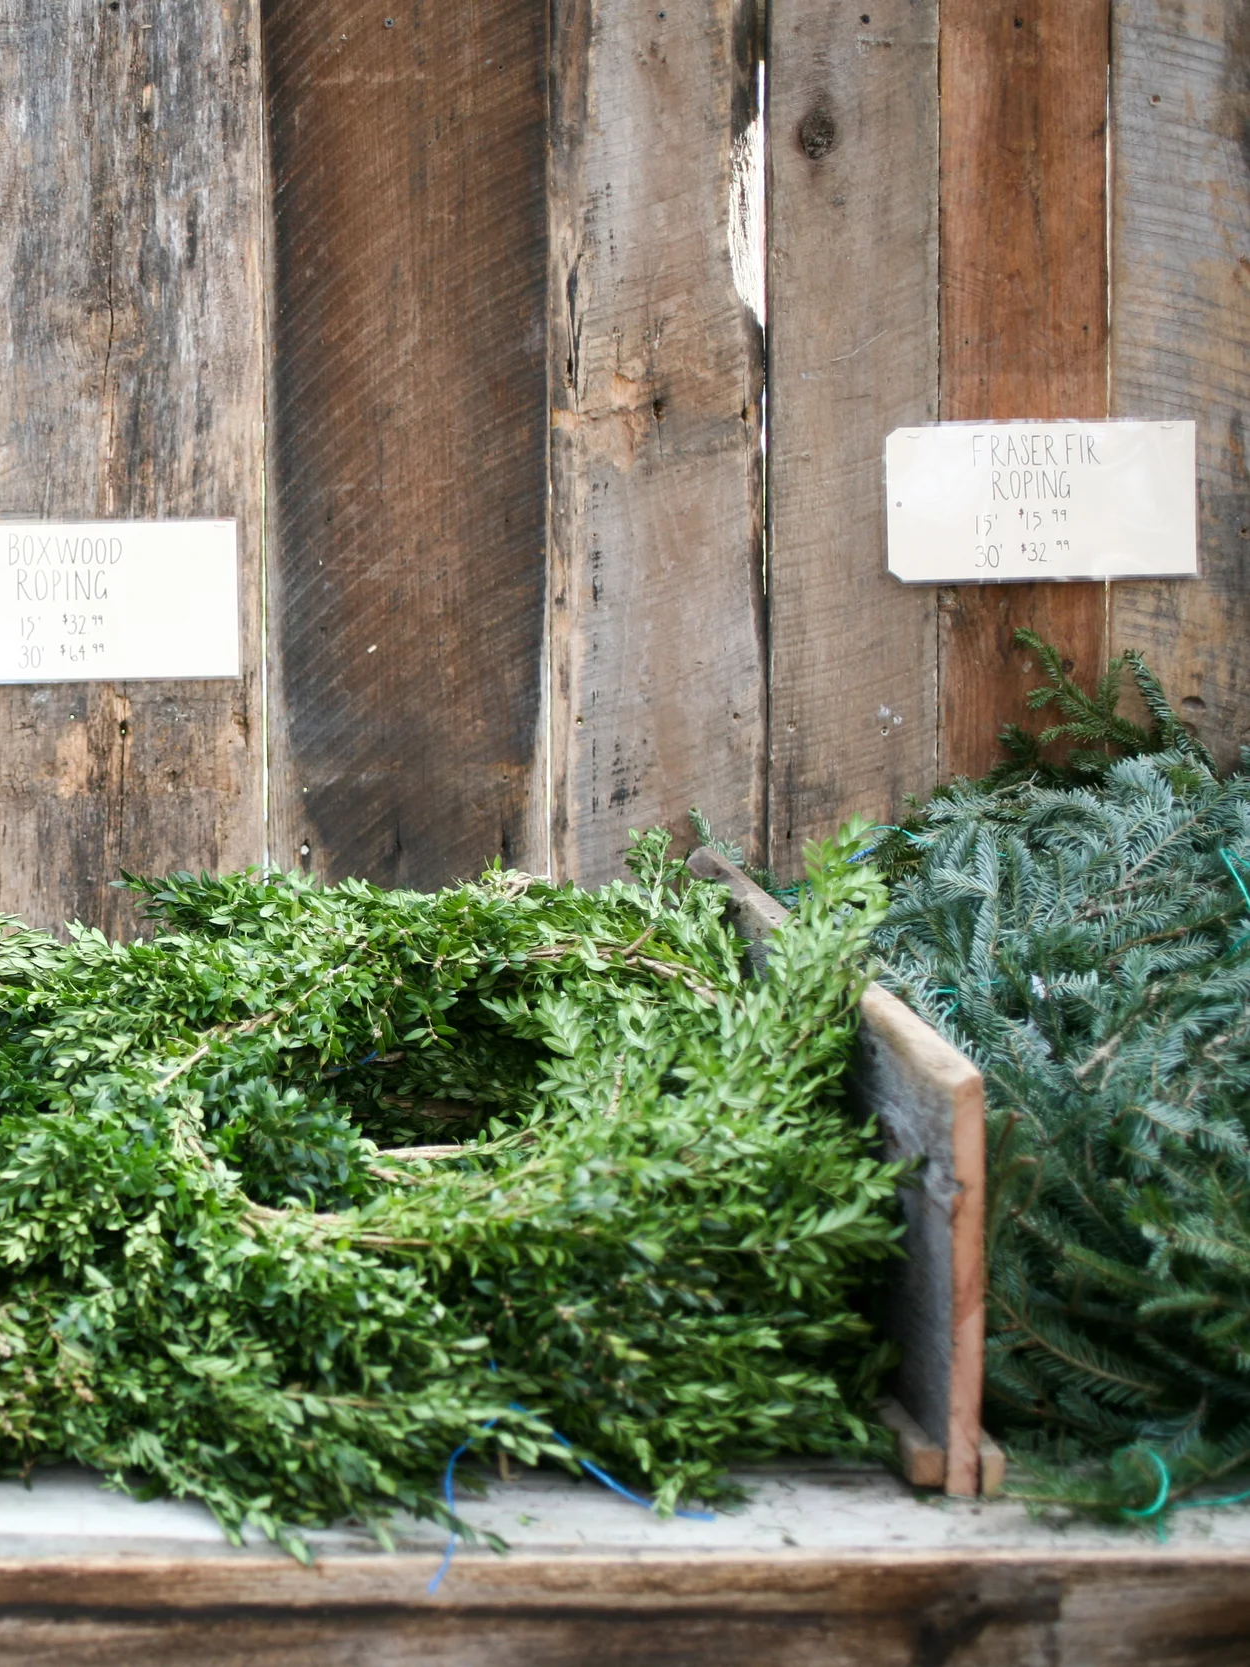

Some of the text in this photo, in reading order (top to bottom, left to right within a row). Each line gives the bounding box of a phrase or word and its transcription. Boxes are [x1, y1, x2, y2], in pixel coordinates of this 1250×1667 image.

[972, 433, 1101, 467] FRASER FIR
[991, 470, 1071, 500] ROPING
[975, 514, 998, 536] 15'
[8, 533, 123, 566] BOXWOOD
[975, 544, 1003, 568] 30'
[16, 568, 108, 601] ROPING
